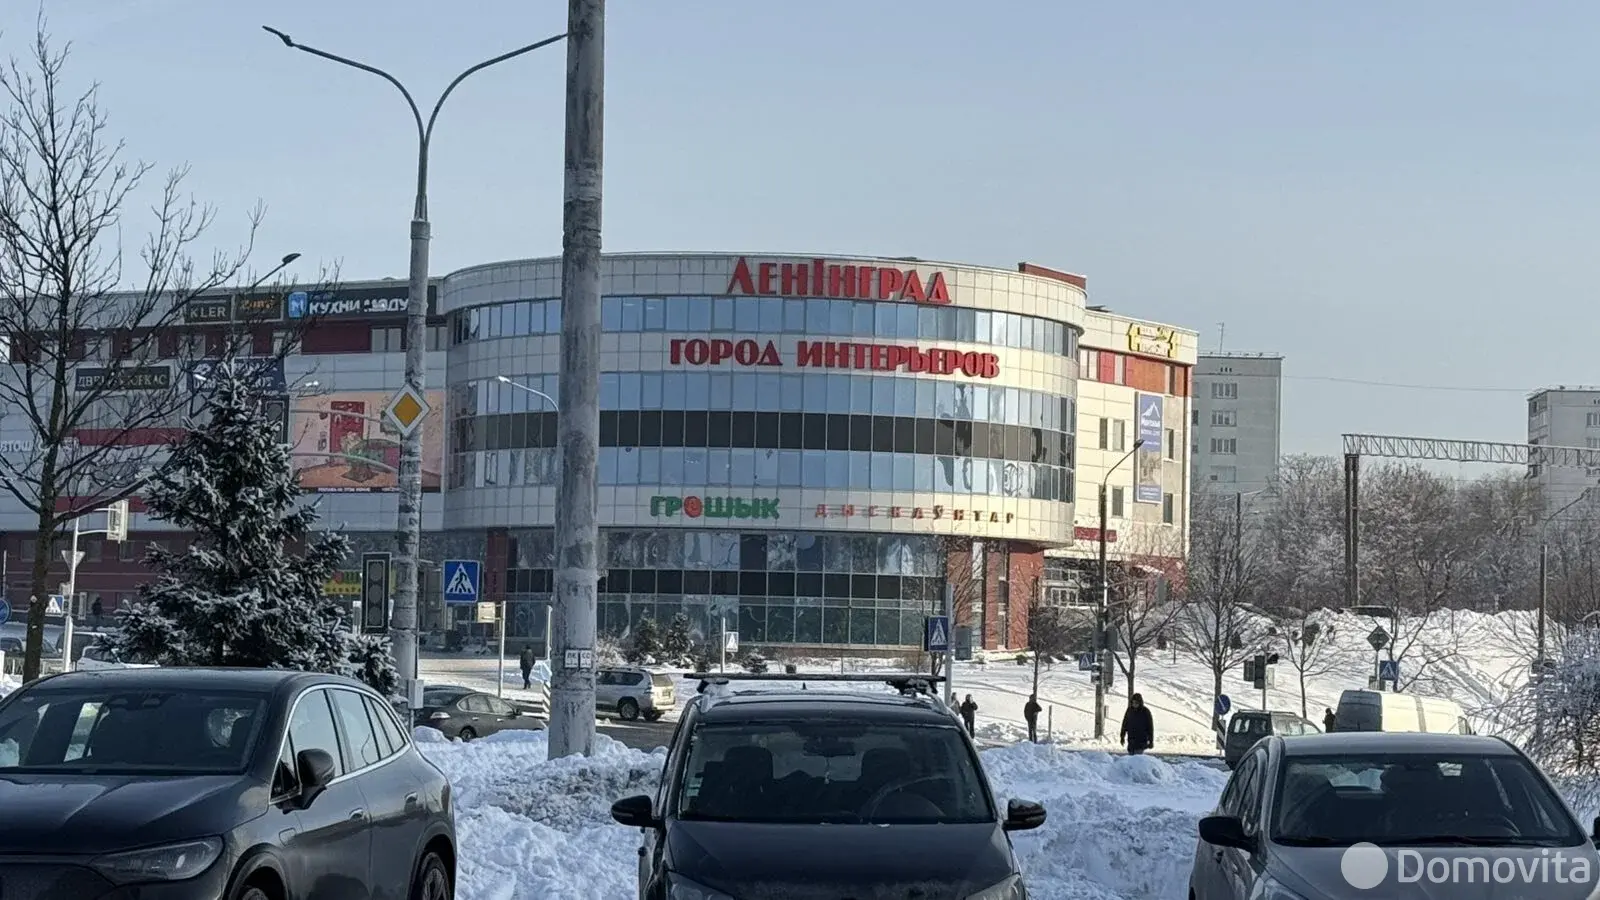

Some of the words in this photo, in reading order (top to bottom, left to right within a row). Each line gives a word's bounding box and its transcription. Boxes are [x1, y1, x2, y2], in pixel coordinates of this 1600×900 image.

[190, 306, 226, 318] KLER
[309, 299, 360, 315] КУХНИ
[670, 338, 782, 366] ГОРОД
[797, 339, 1000, 378] ИНТЕРЬЕРОВ
[650, 496, 779, 519] ГРОШЫК
